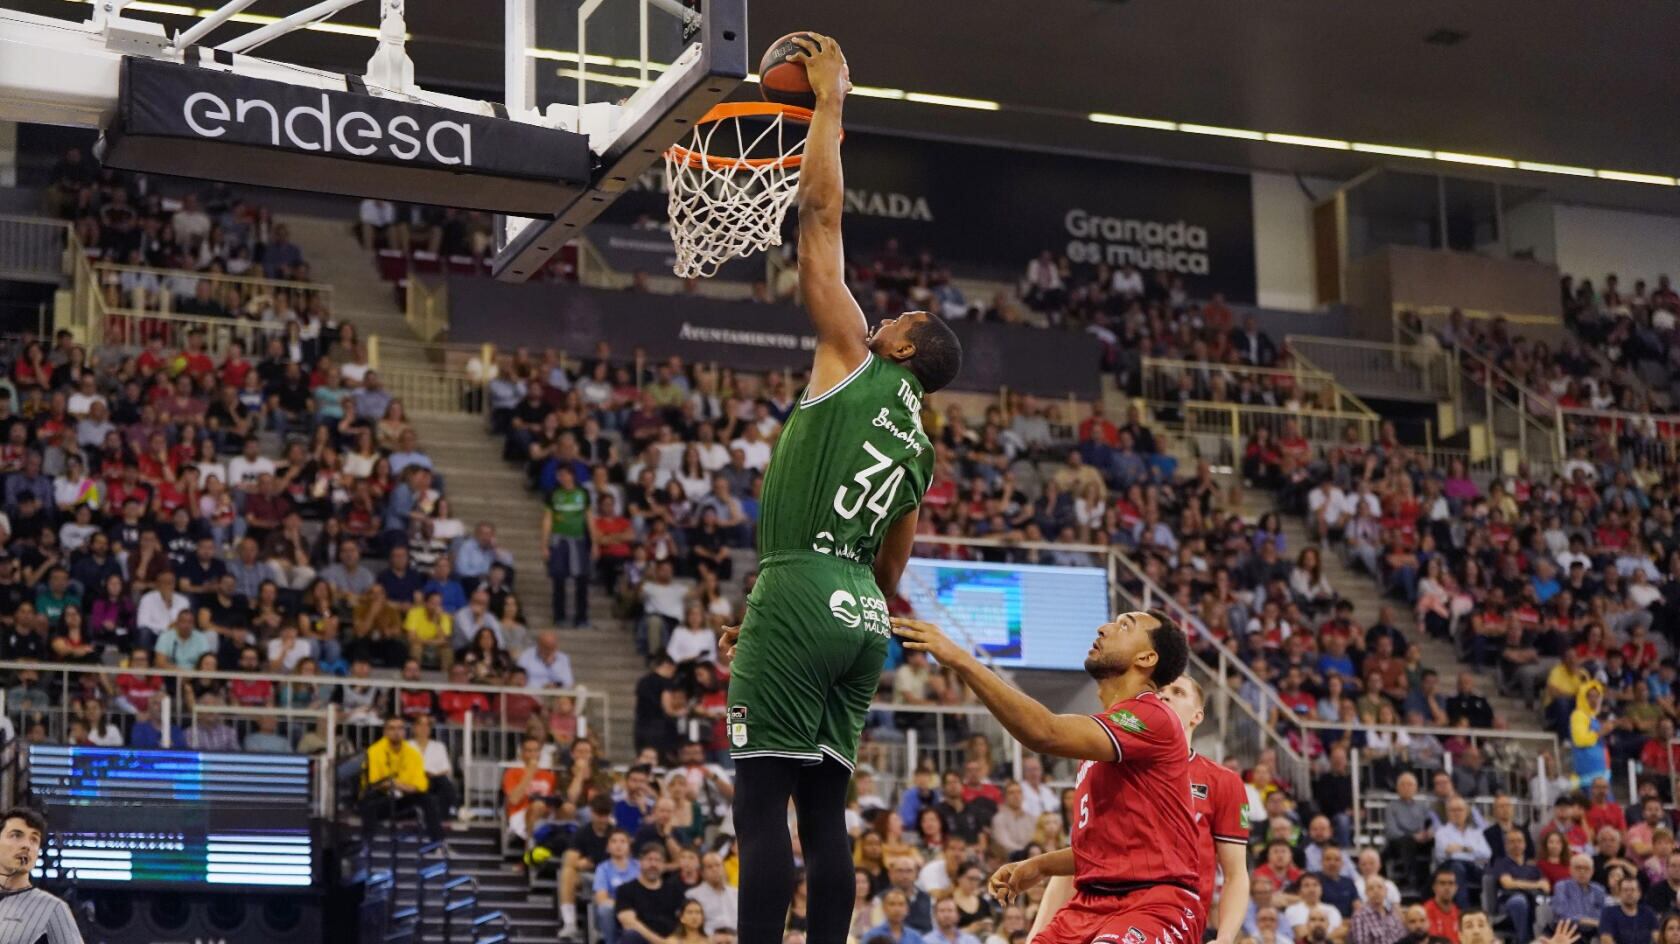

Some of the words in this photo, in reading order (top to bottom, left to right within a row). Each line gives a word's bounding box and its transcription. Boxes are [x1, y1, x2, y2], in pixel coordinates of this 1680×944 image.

[183, 91, 472, 166] endesa
[843, 188, 935, 223] NADA
[1065, 208, 1208, 249] Granada
[1066, 240, 1101, 264] es
[1106, 243, 1210, 275] música
[834, 440, 905, 536] 34
[860, 596, 889, 615] COST
[863, 610, 881, 621] DEL
[864, 619, 891, 639] MÁLAG
[1078, 793, 1089, 830] 5
